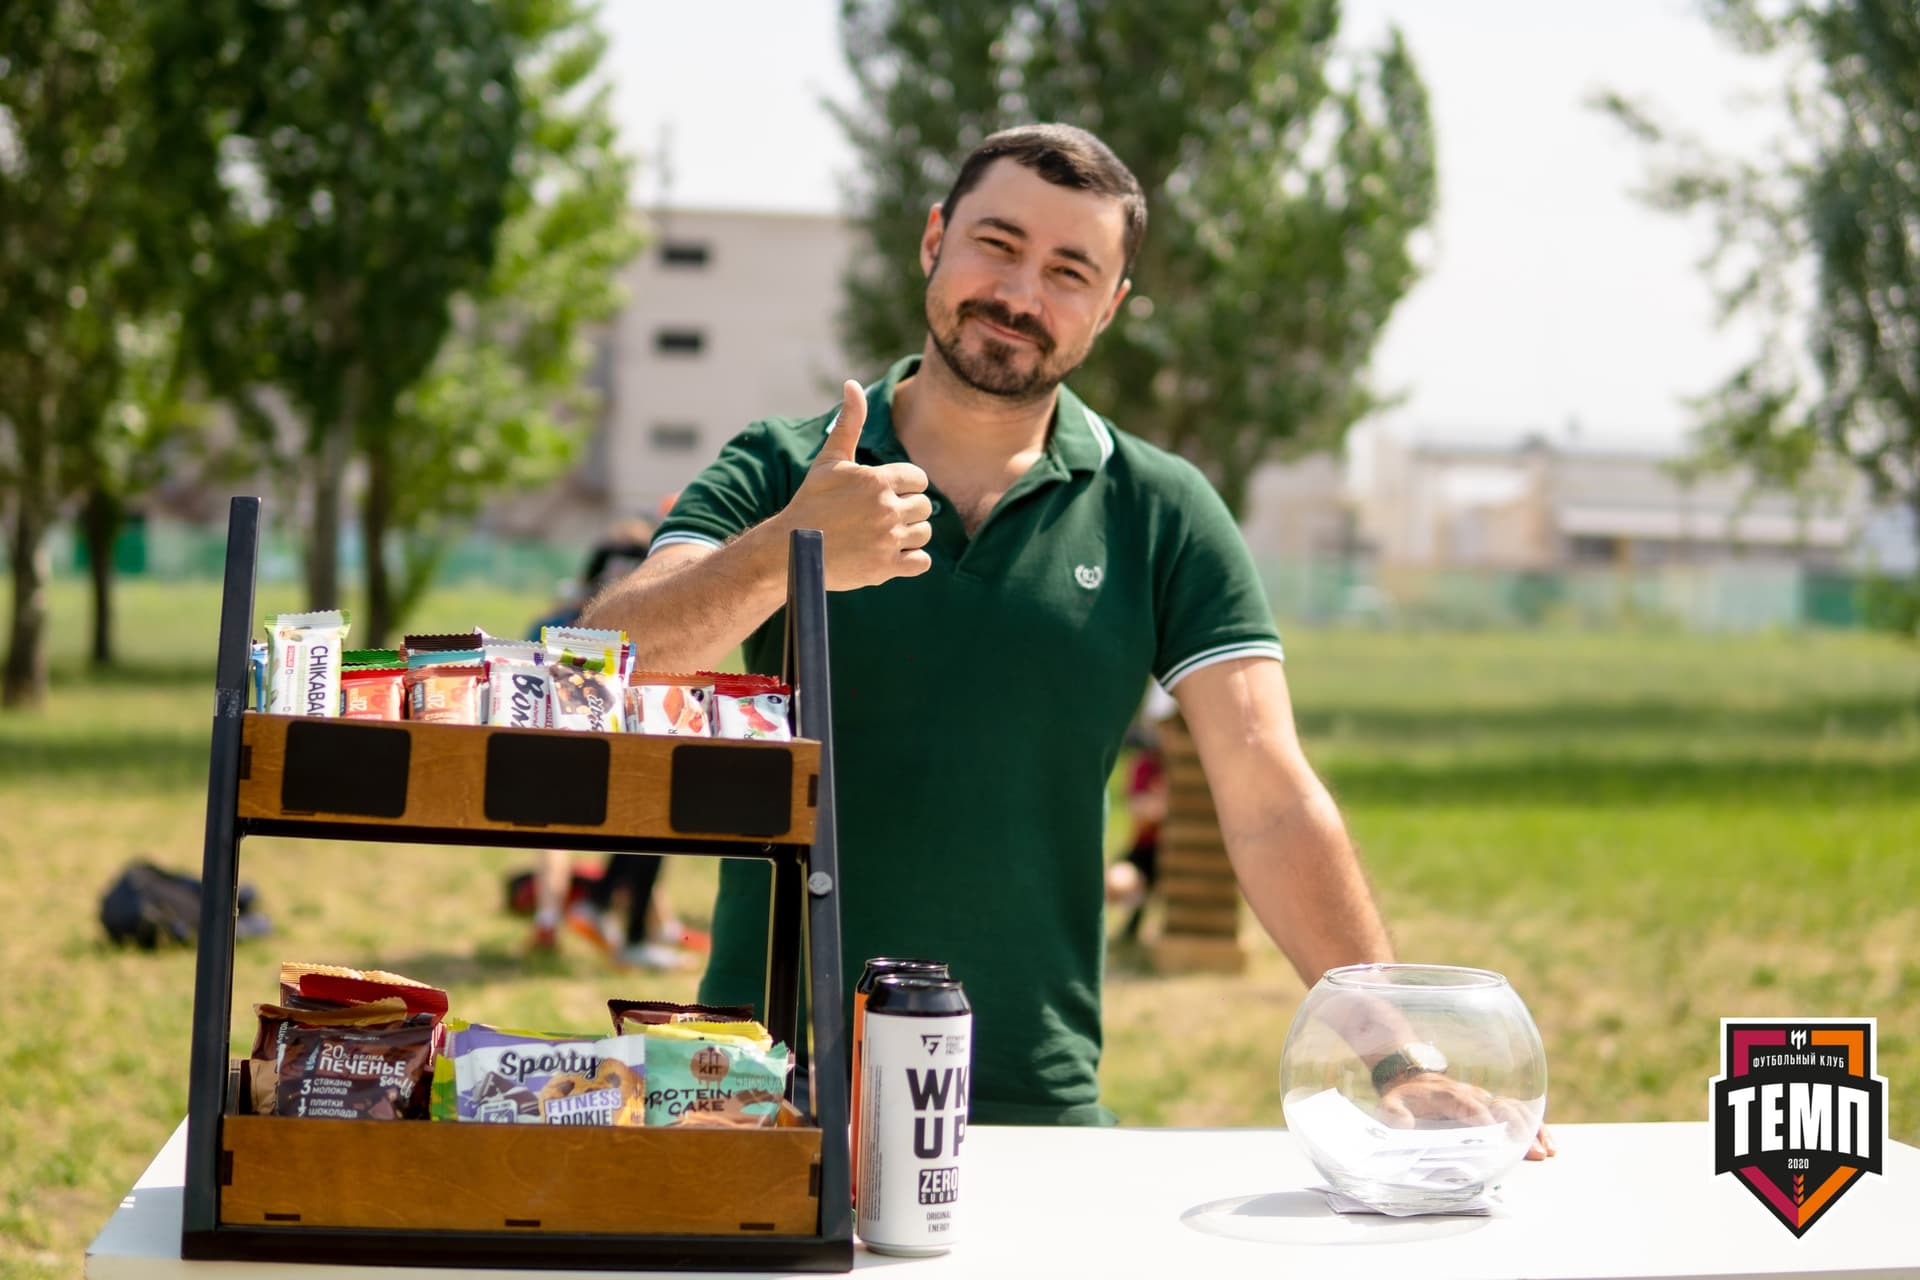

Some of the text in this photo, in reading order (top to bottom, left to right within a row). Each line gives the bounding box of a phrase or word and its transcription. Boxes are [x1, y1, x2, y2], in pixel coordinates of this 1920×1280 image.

[319, 1056, 407, 1076] ПЕЧЕНЬЕ
[500, 1050, 603, 1083] Sporty
[699, 1050, 721, 1065] FIT
[300, 1079, 312, 1095] 3
[546, 1089, 622, 1114] FITNESS
[645, 1088, 732, 1109] ROTEIN
[668, 1100, 725, 1116] CAKE
[913, 1114, 966, 1159] UP
[921, 1169, 958, 1193] ZERO
